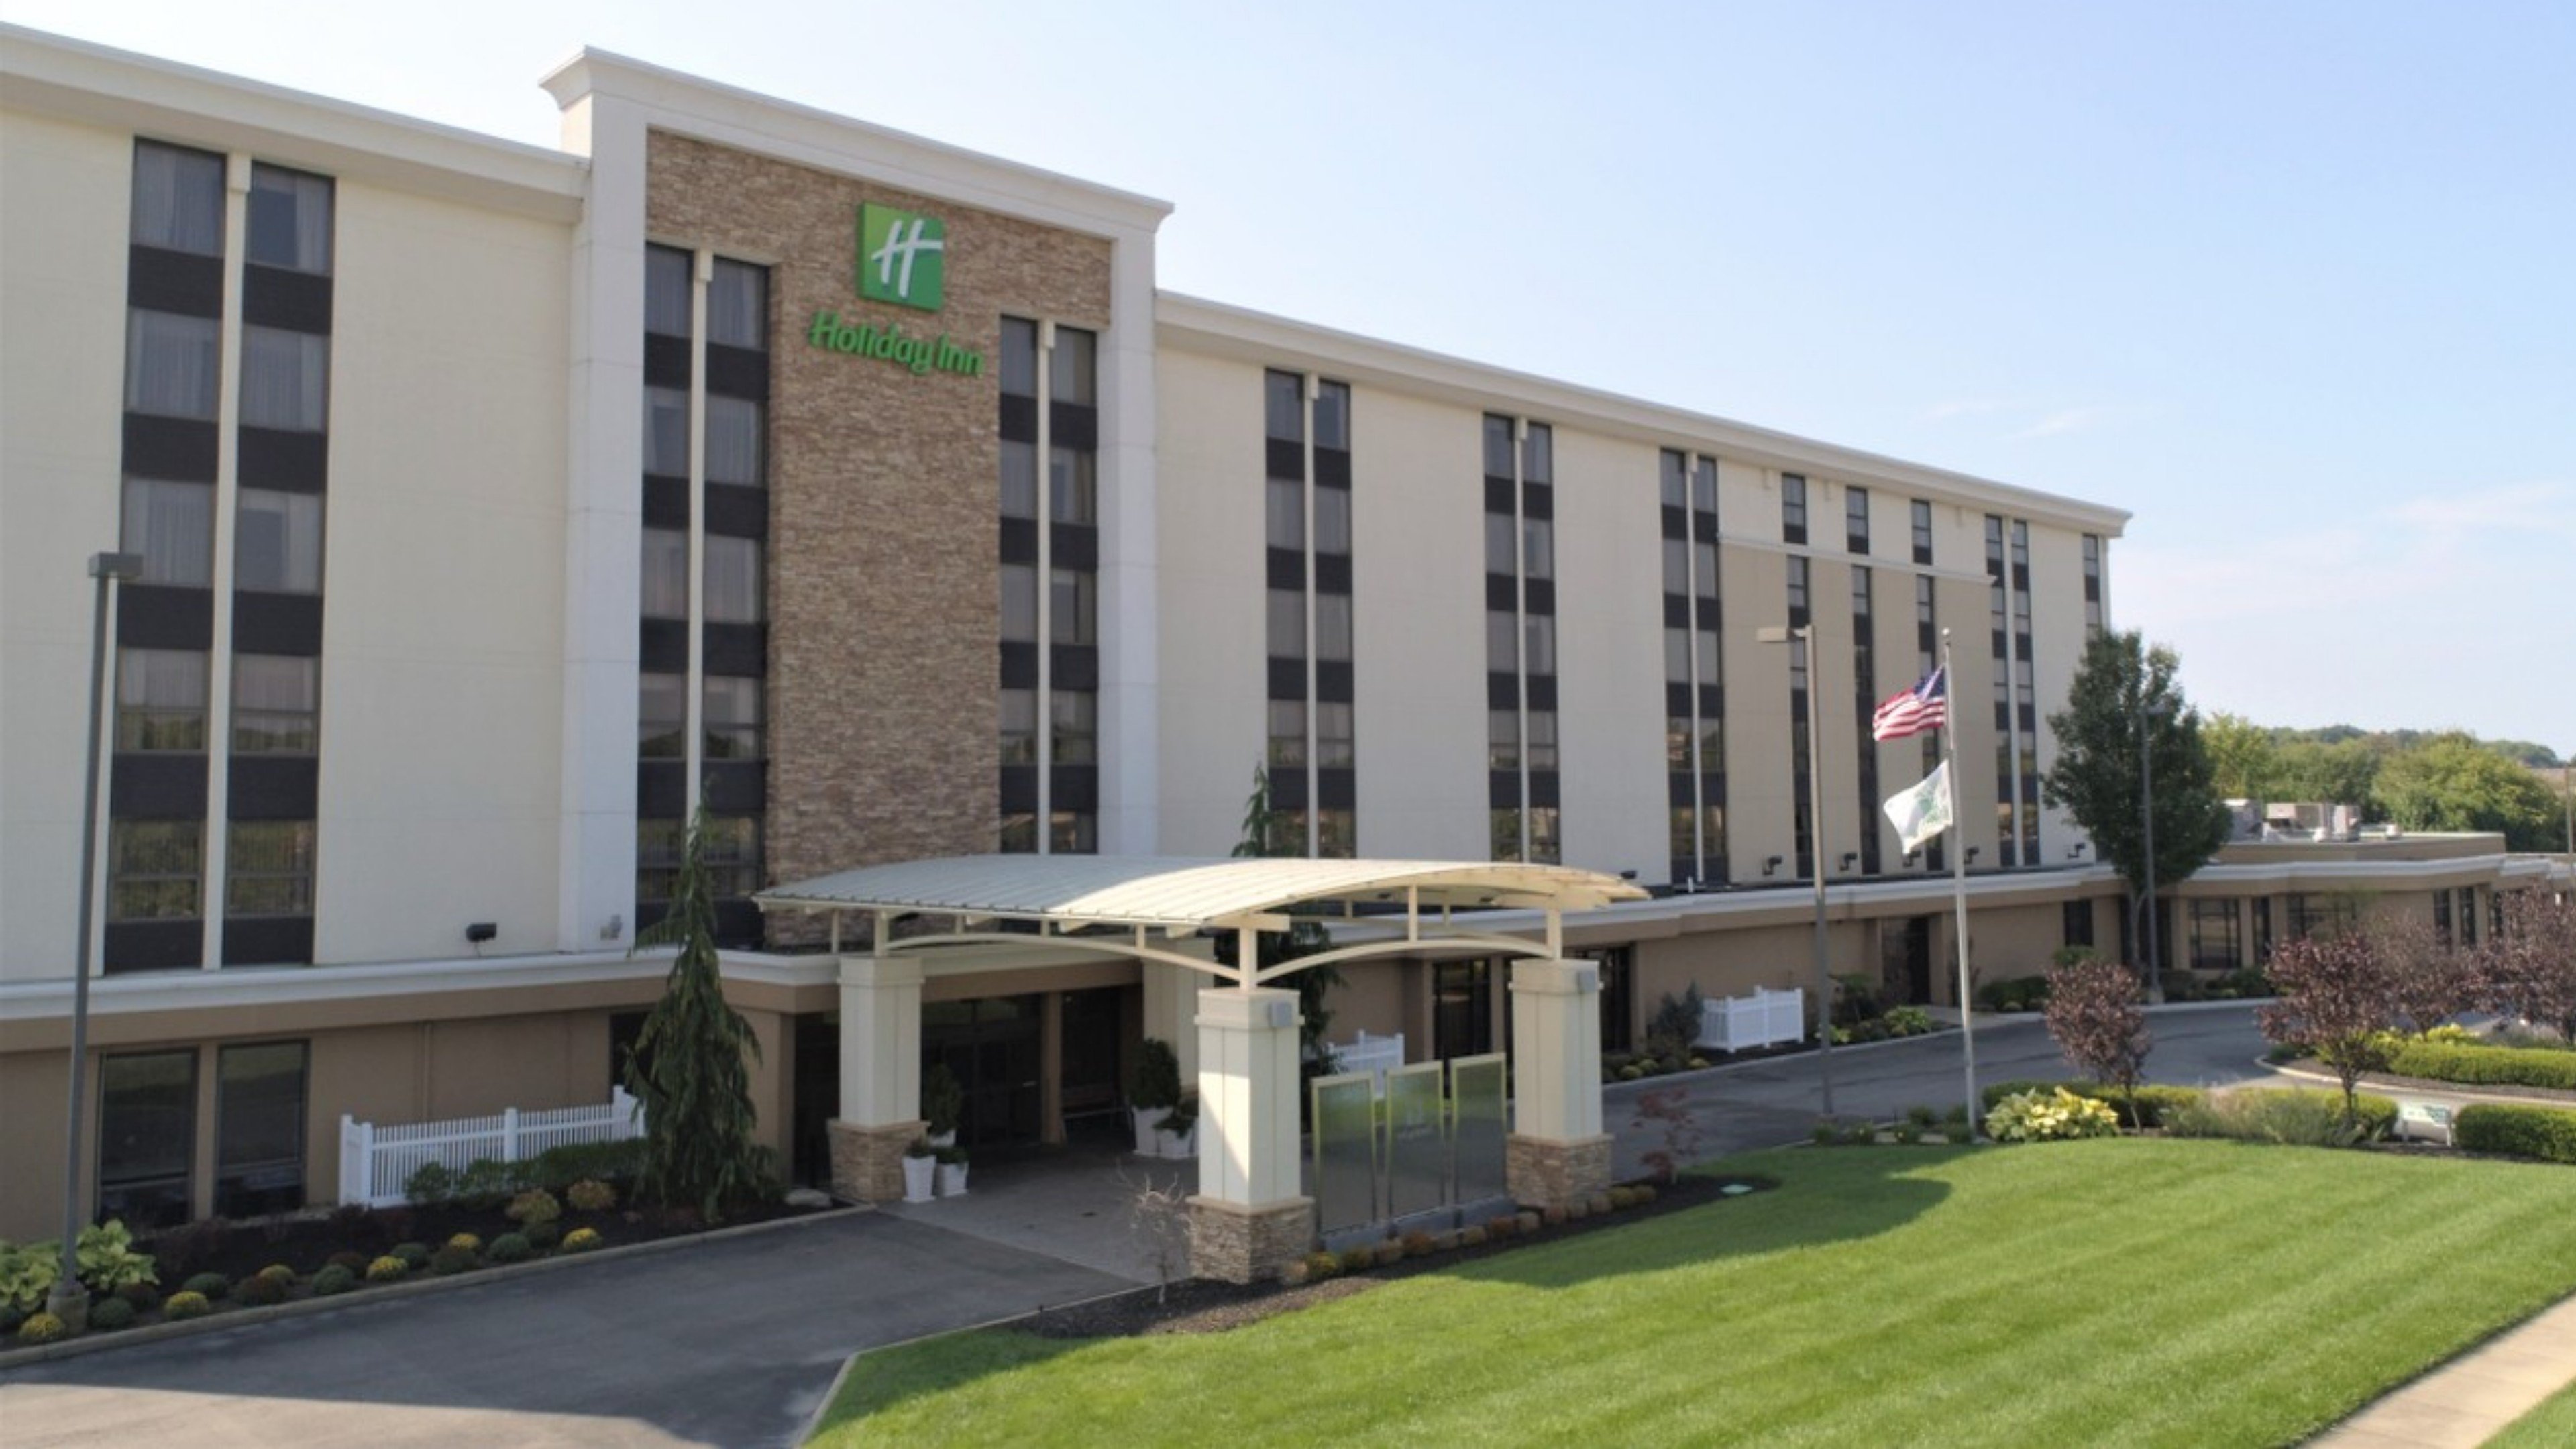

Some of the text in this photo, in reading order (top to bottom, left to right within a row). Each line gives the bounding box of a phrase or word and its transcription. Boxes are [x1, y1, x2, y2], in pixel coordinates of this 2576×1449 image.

[871, 219, 943, 297] H
[809, 311, 984, 377] Holiday Inn
